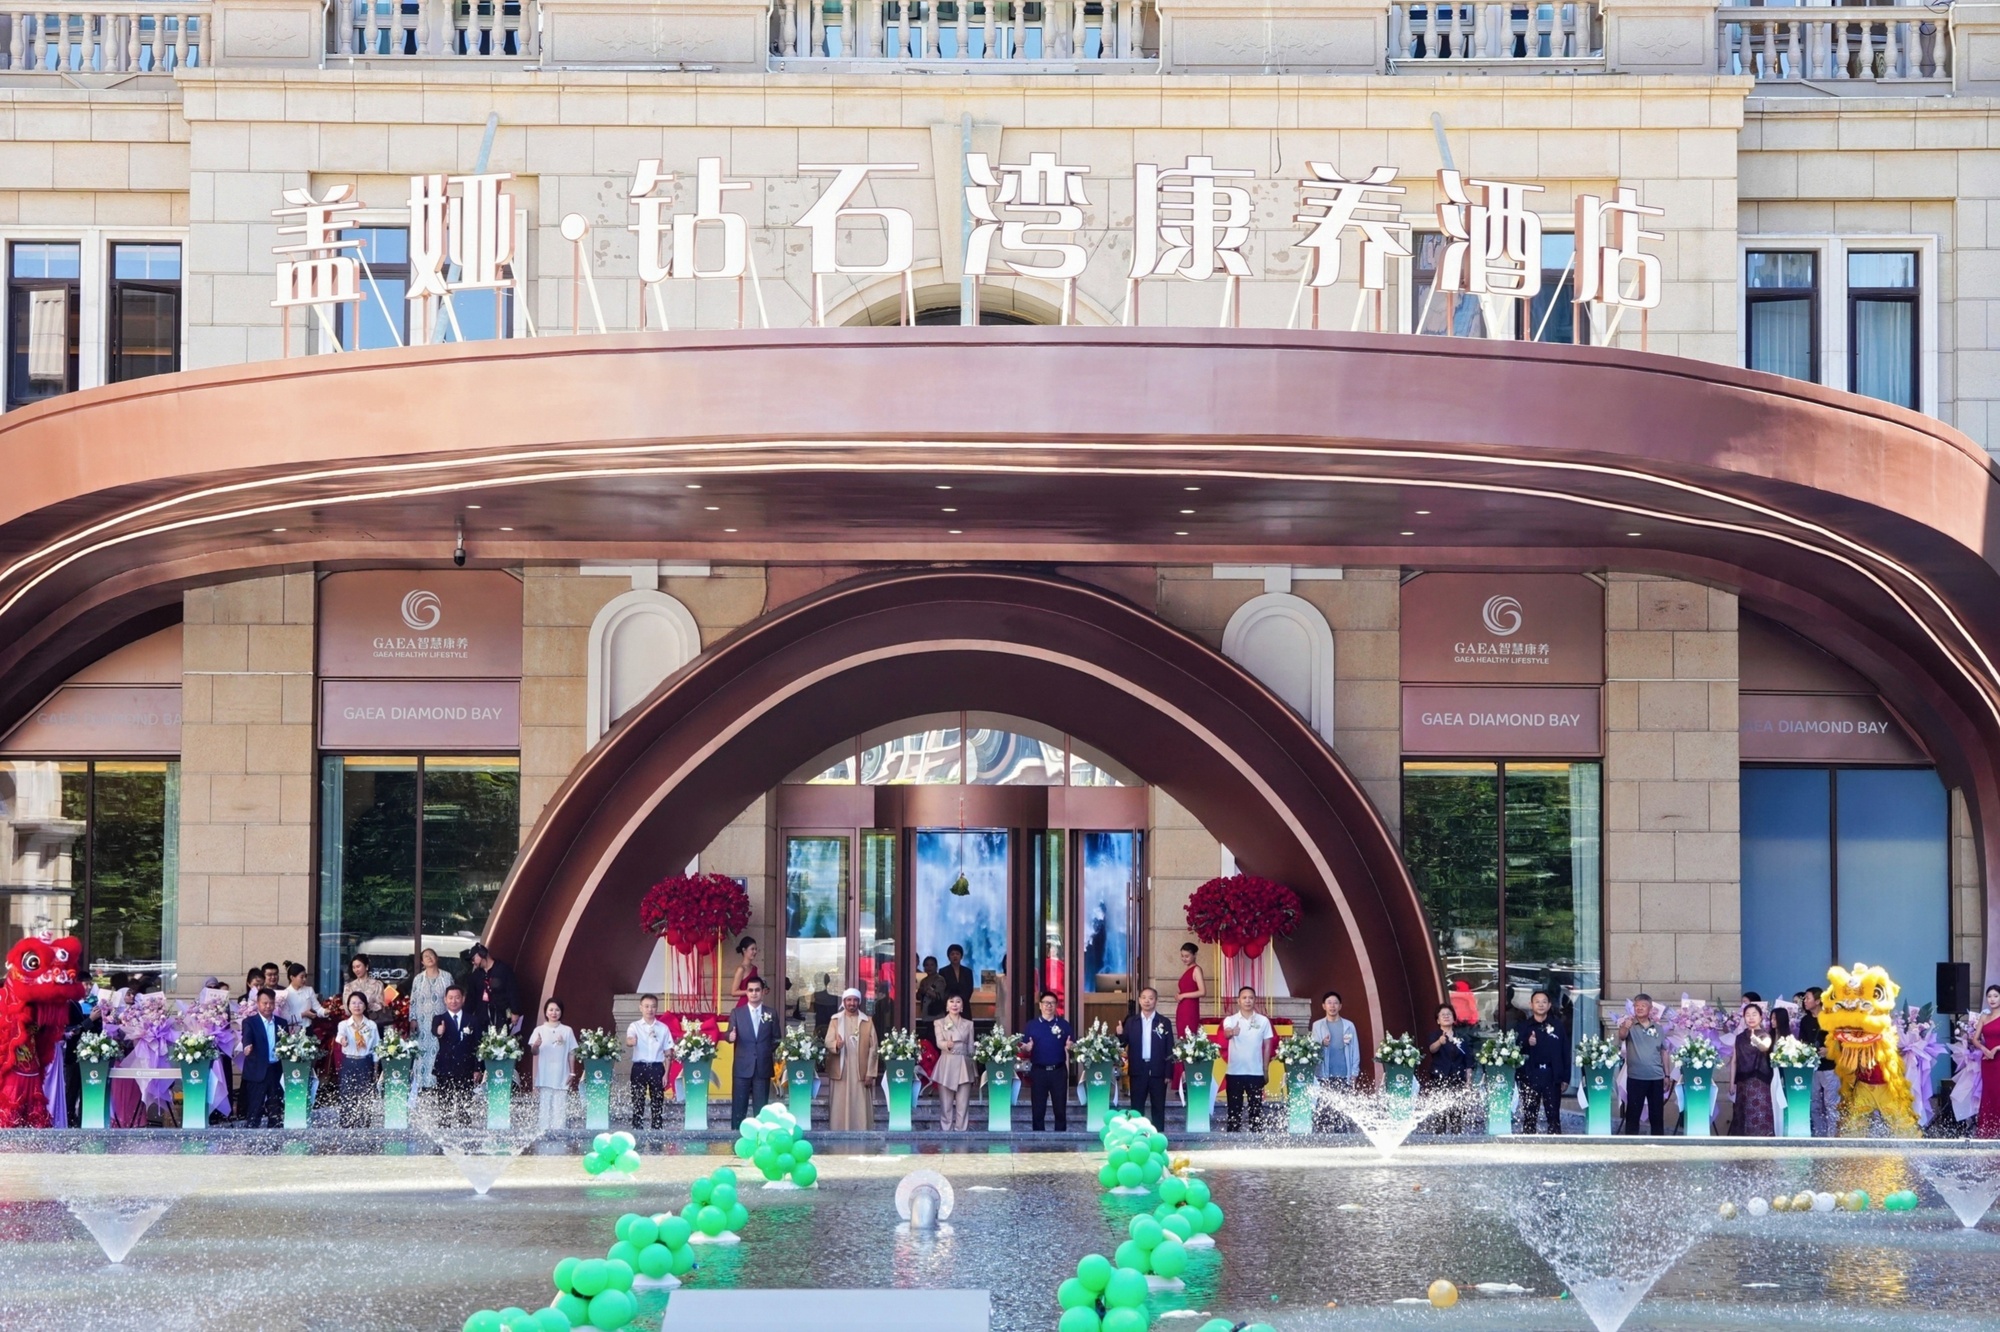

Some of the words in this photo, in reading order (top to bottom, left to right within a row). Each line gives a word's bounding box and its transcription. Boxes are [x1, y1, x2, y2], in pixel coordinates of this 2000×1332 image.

[373, 637, 469, 650] GAEA智慧康养
[1454, 642, 1550, 656] GAEA智慧康养
[430, 651, 468, 659] LIFESTYLE
[1476, 656, 1509, 664] HEALTHY
[1511, 656, 1550, 665] LIFESTYLE
[37, 713, 77, 726] GAEA
[84, 713, 159, 726] DIAMOND
[343, 707, 386, 720] GAEA
[391, 707, 468, 720] DIAMOND
[471, 707, 503, 720] BAY
[1421, 713, 1464, 726] GAEA
[1469, 713, 1545, 727] DIAMOND
[1549, 714, 1581, 727] BAY
[1777, 720, 1854, 734] DIAMOND
[1857, 721, 1889, 734] BAY
